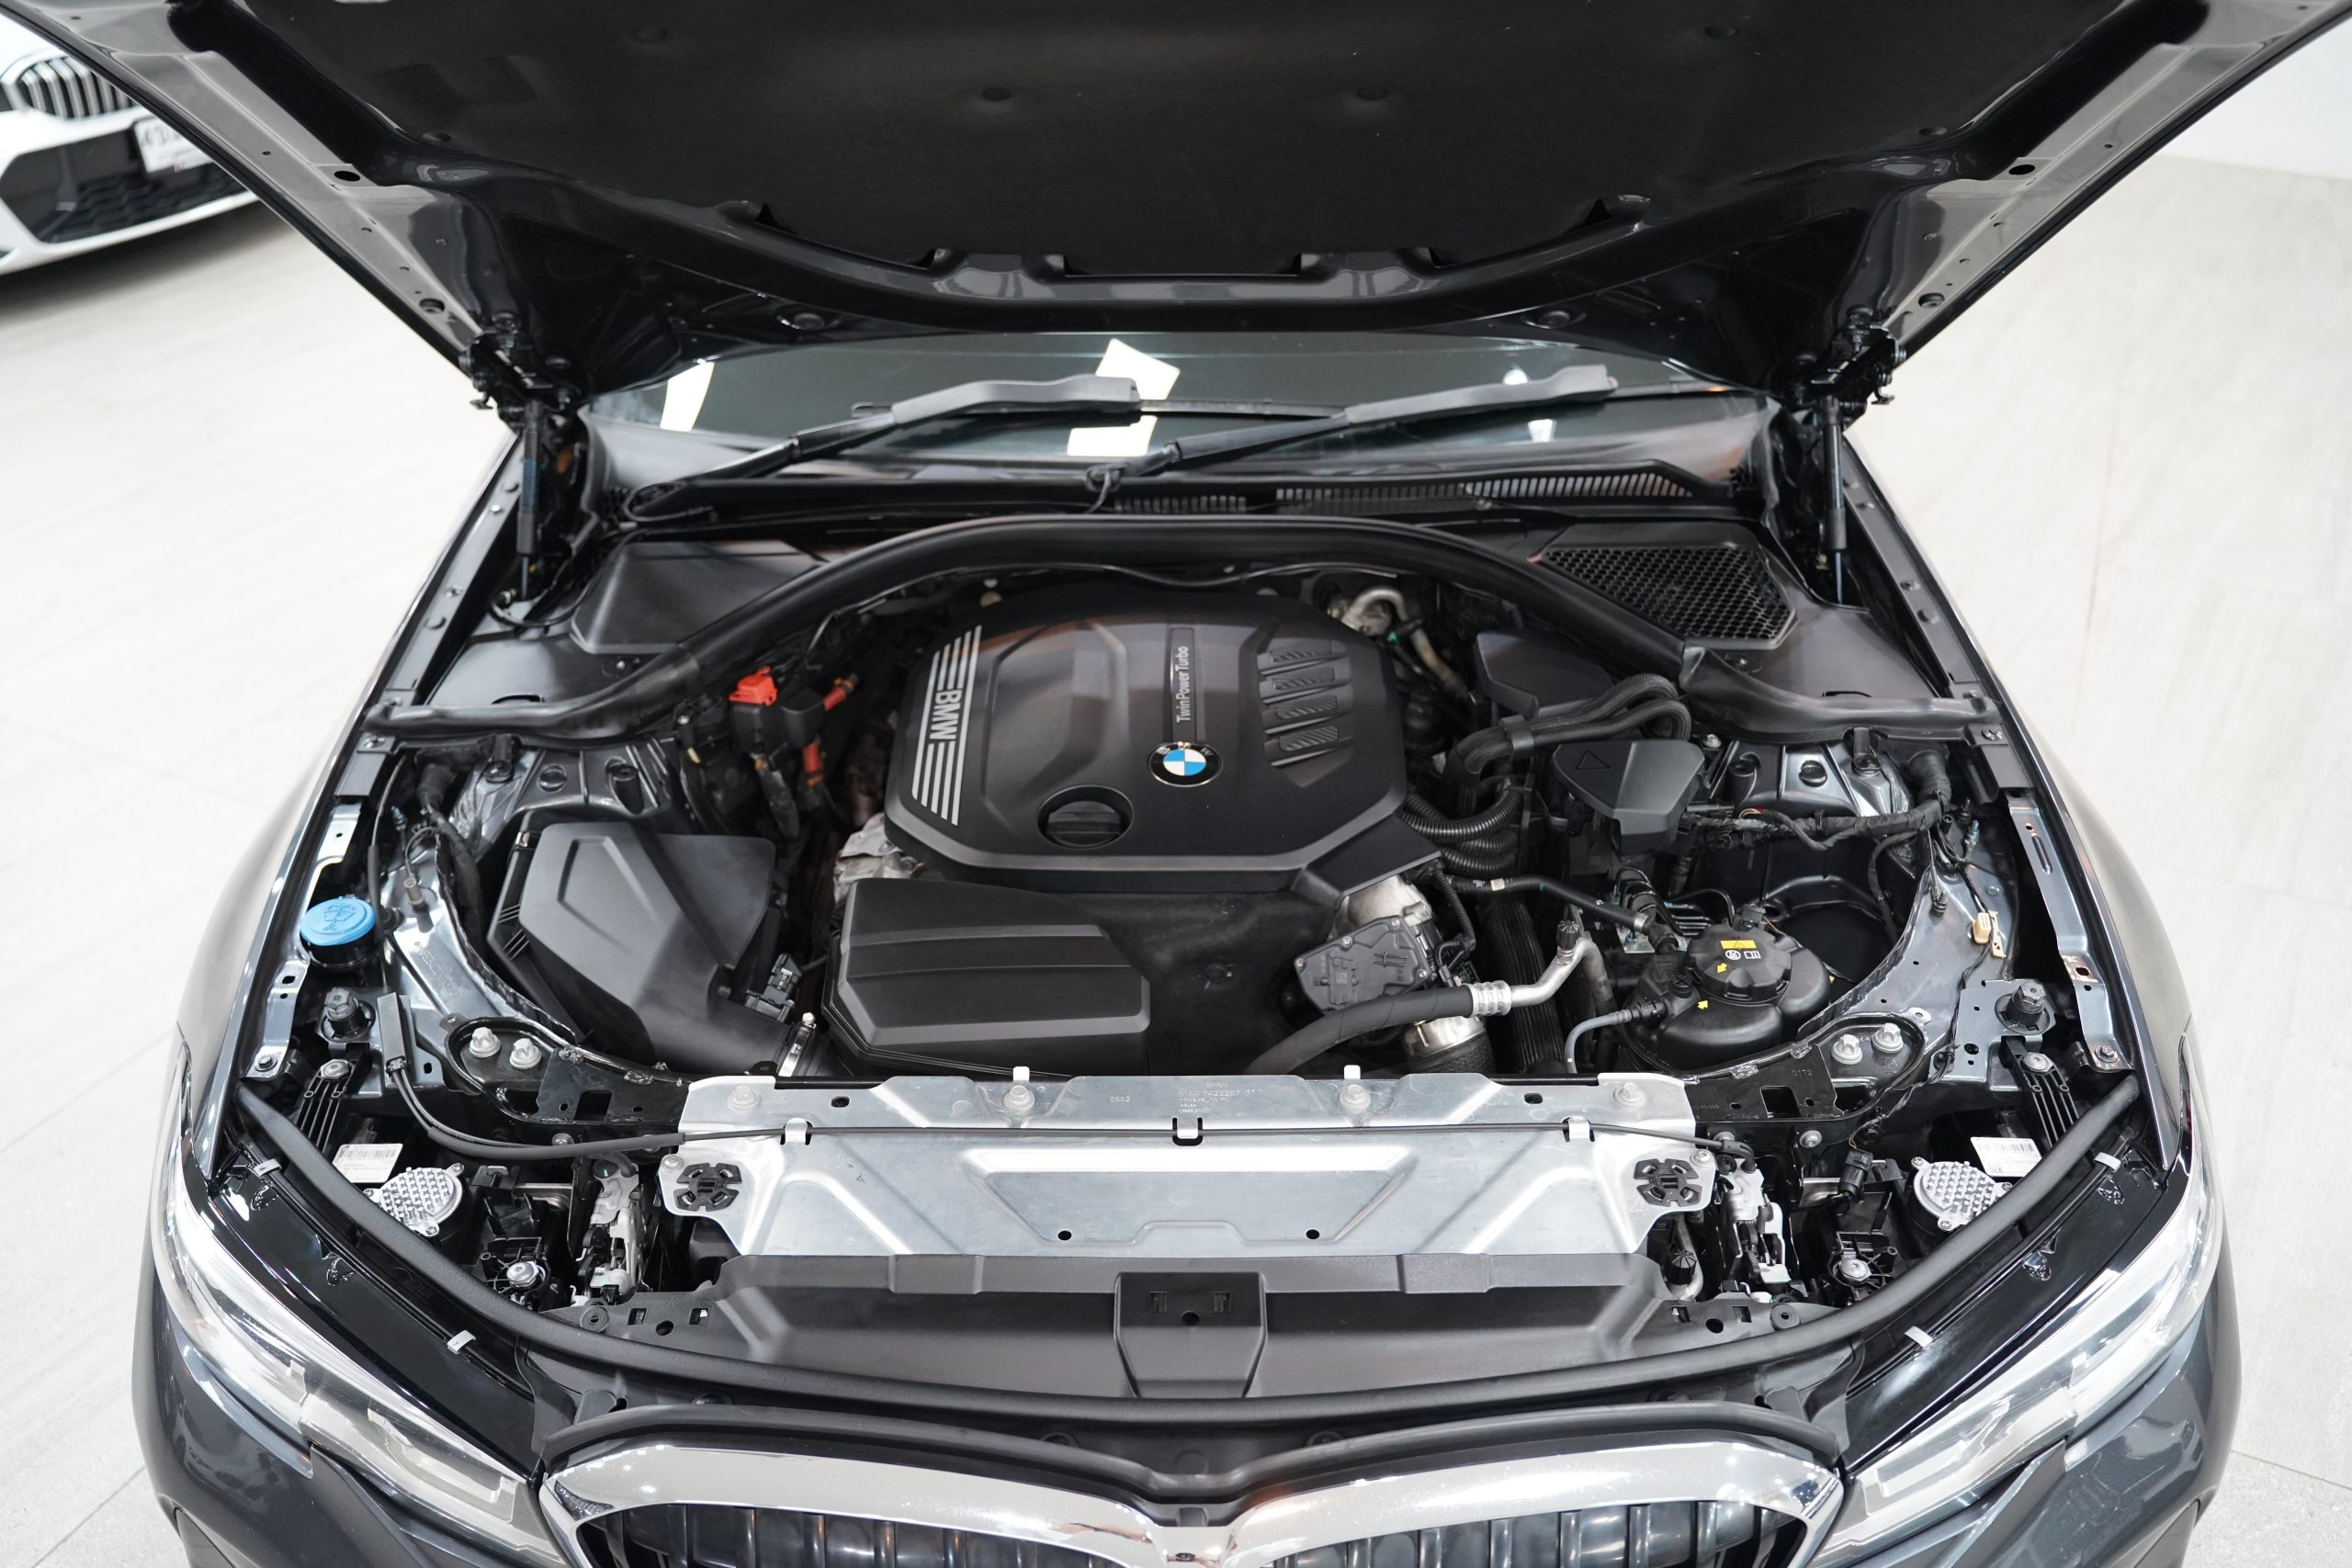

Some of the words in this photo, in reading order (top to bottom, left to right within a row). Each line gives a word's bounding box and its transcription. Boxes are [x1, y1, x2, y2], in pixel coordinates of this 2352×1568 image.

[1175, 646, 1190, 671] Turbo
[930, 689, 963, 740] BMW
[1176, 671, 1191, 723] TwinPower
